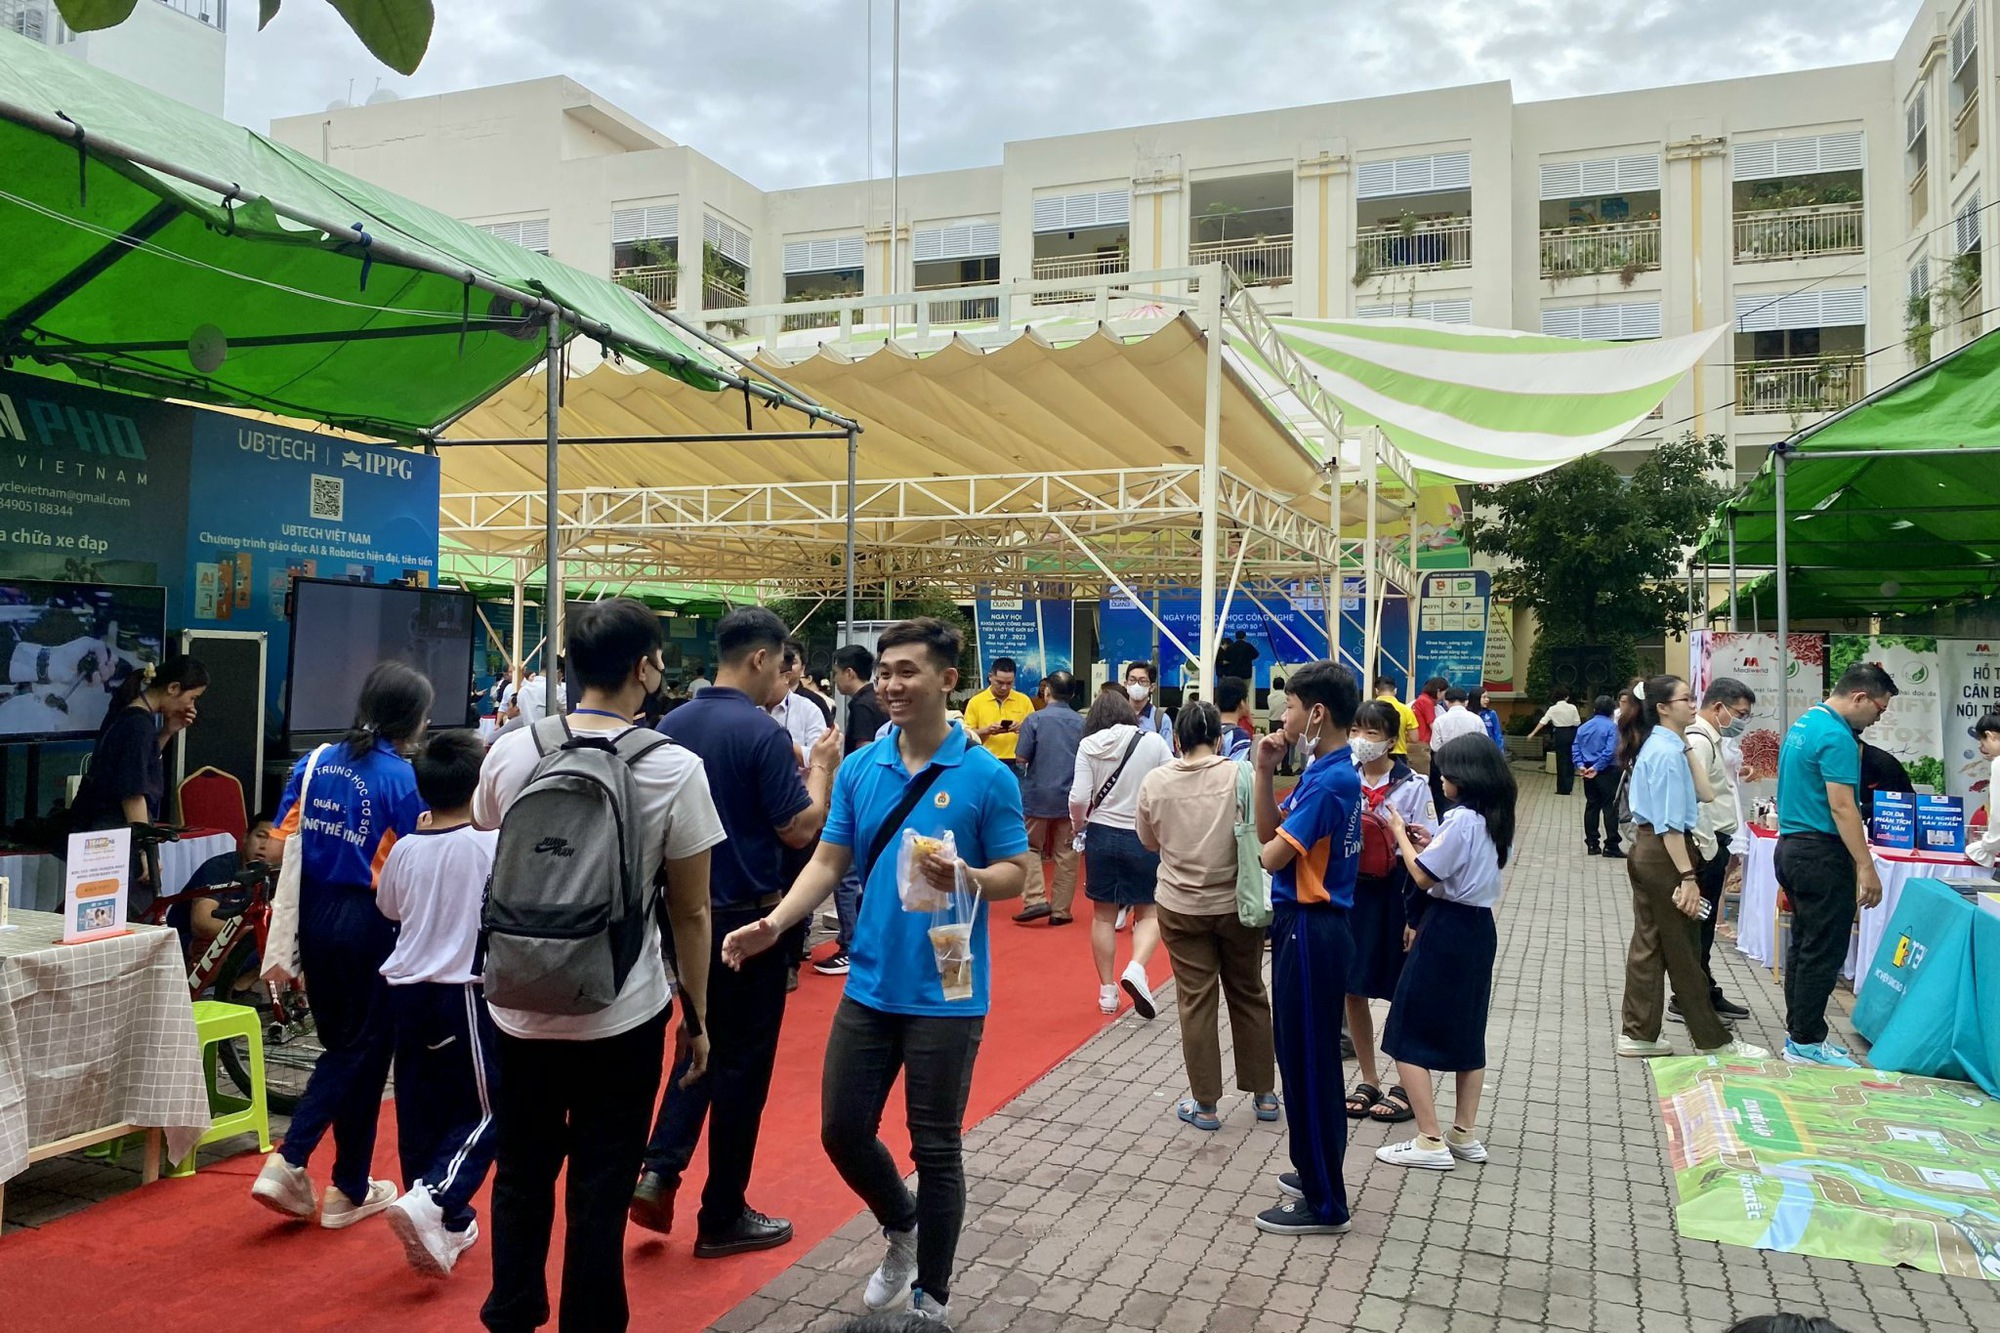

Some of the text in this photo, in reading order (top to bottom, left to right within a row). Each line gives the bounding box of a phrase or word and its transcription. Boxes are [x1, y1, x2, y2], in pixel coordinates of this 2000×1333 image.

[238, 428, 316, 462] UBTECH
[17, 454, 148, 485] VIETNAM
[365, 452, 412, 480] IPPG
[0, 480, 131, 506] yclevietnam@gmail.com
[11, 528, 51, 546] chữa
[56, 535, 75, 548] xe
[78, 534, 109, 554] đạp
[281, 524, 371, 545] UBTECH VIỆT NAM
[199, 531, 241, 549] Chương
[243, 535, 267, 550] trình
[268, 537, 289, 552] giáo
[291, 540, 308, 556] dục
[309, 544, 319, 555] AI
[320, 545, 327, 556] &
[329, 546, 365, 560] Robotics
[366, 550, 385, 562] hiện
[402, 554, 416, 564] tiên
[418, 554, 433, 567] tiến
[1010, 613, 1022, 621] HỘI
[1163, 612, 1185, 620] NGÀY
[1186, 613, 1200, 621] HỘI
[1245, 612, 1269, 621] CÔNG
[1271, 614, 1294, 622] GHỆ
[1963, 683, 1989, 698] CÂN
[1956, 702, 1978, 719] NỘI
[1864, 727, 1934, 744] ETOX
[315, 765, 353, 778] TRUNG
[351, 774, 368, 797] HỌC
[313, 798, 340, 812] QUẬN
[320, 820, 346, 837] THẾ
[1896, 817, 1911, 825] TÍCH
